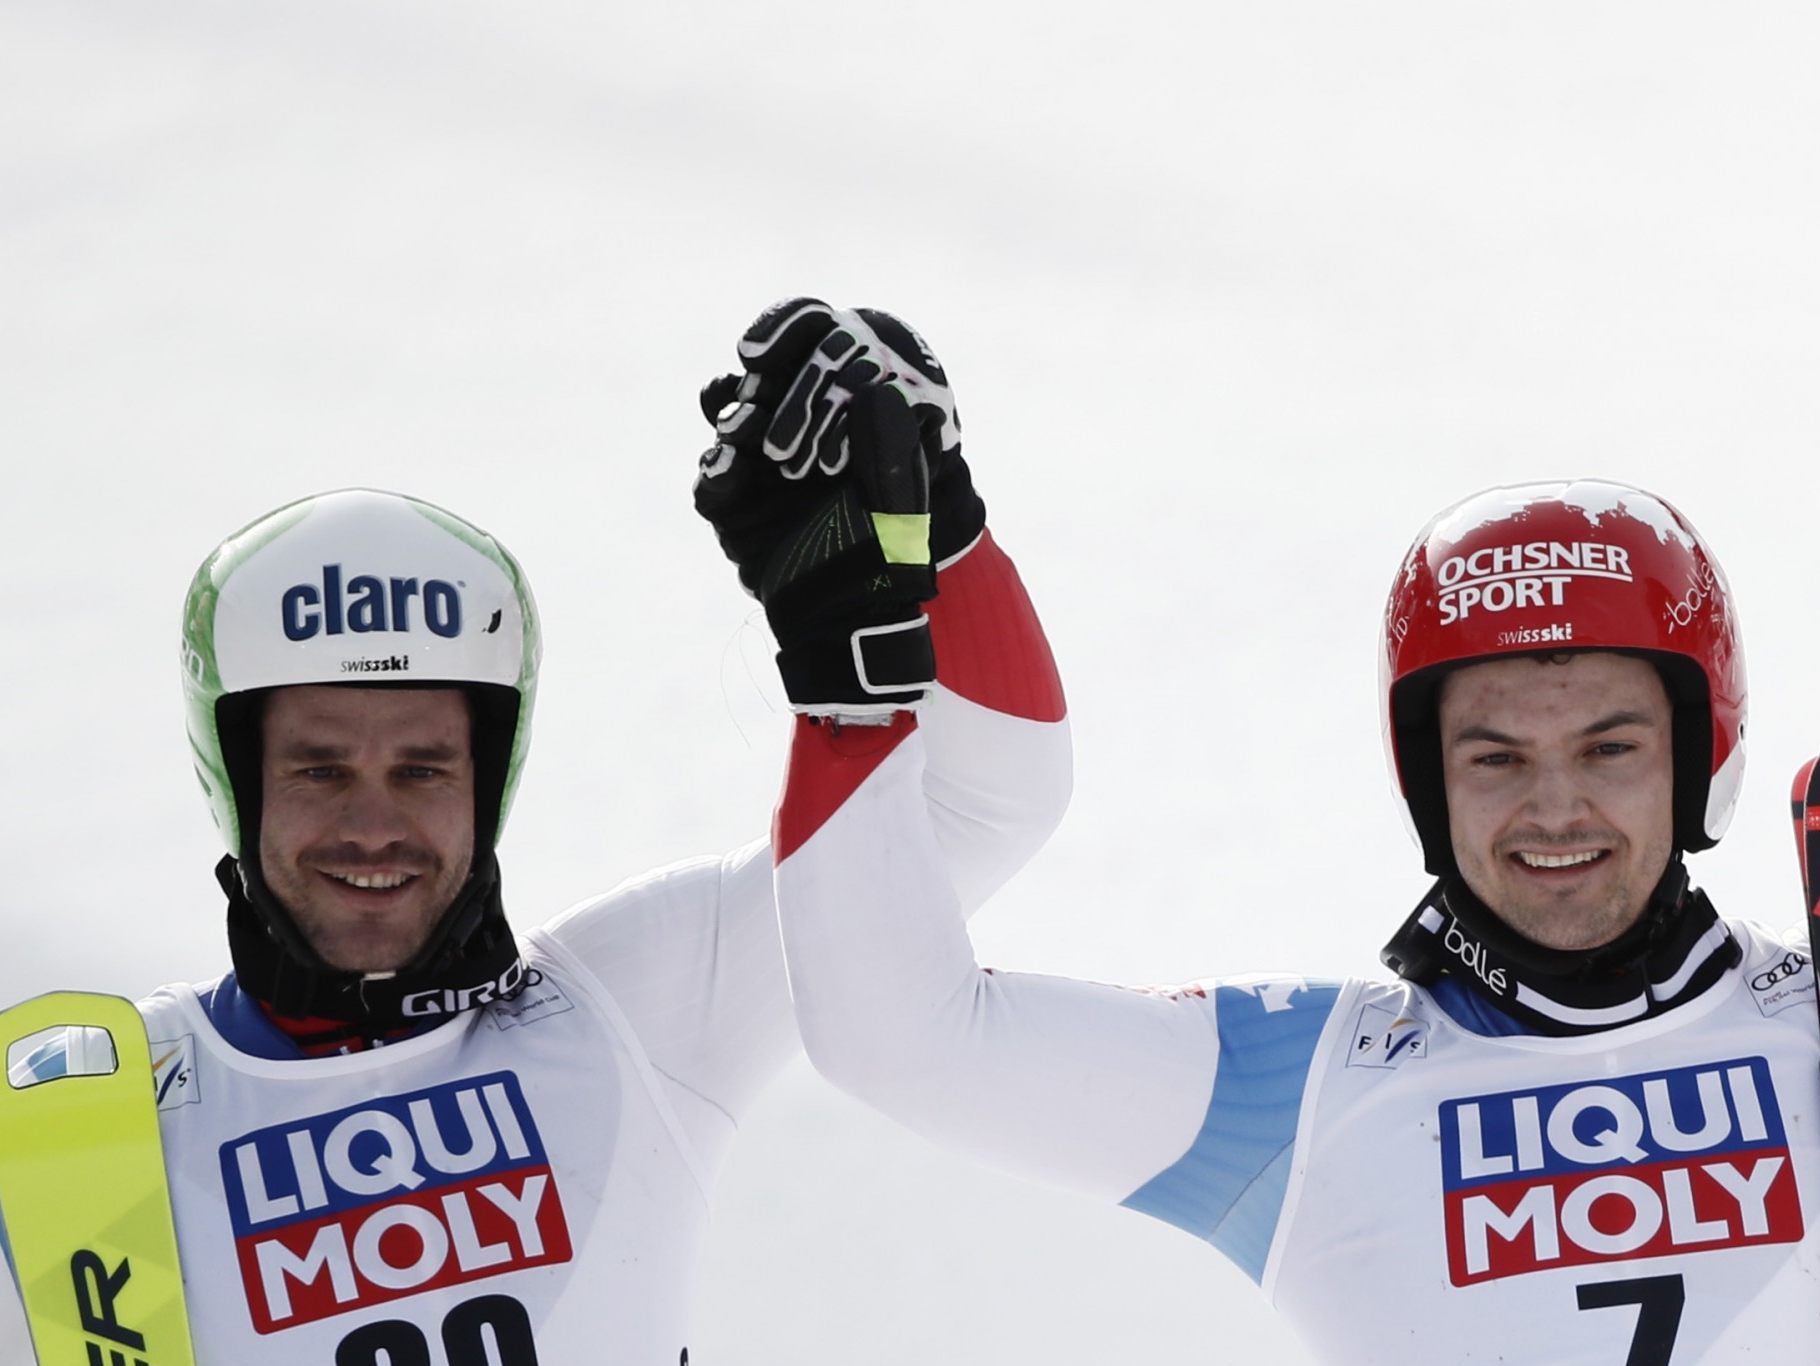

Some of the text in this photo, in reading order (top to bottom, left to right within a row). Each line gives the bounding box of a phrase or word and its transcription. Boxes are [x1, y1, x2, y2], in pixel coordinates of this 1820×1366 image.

[281, 563, 463, 642] claro
[1438, 541, 1633, 587] OCHSNER
[1439, 576, 1572, 626] SPORT
[1497, 622, 1572, 647] swissski
[402, 957, 523, 1017] GIRO
[235, 1081, 532, 1225] LIQUI
[1456, 1065, 1768, 1180] LIQUI
[254, 1173, 549, 1322] MOLY
[1462, 1156, 1786, 1276] MOLY
